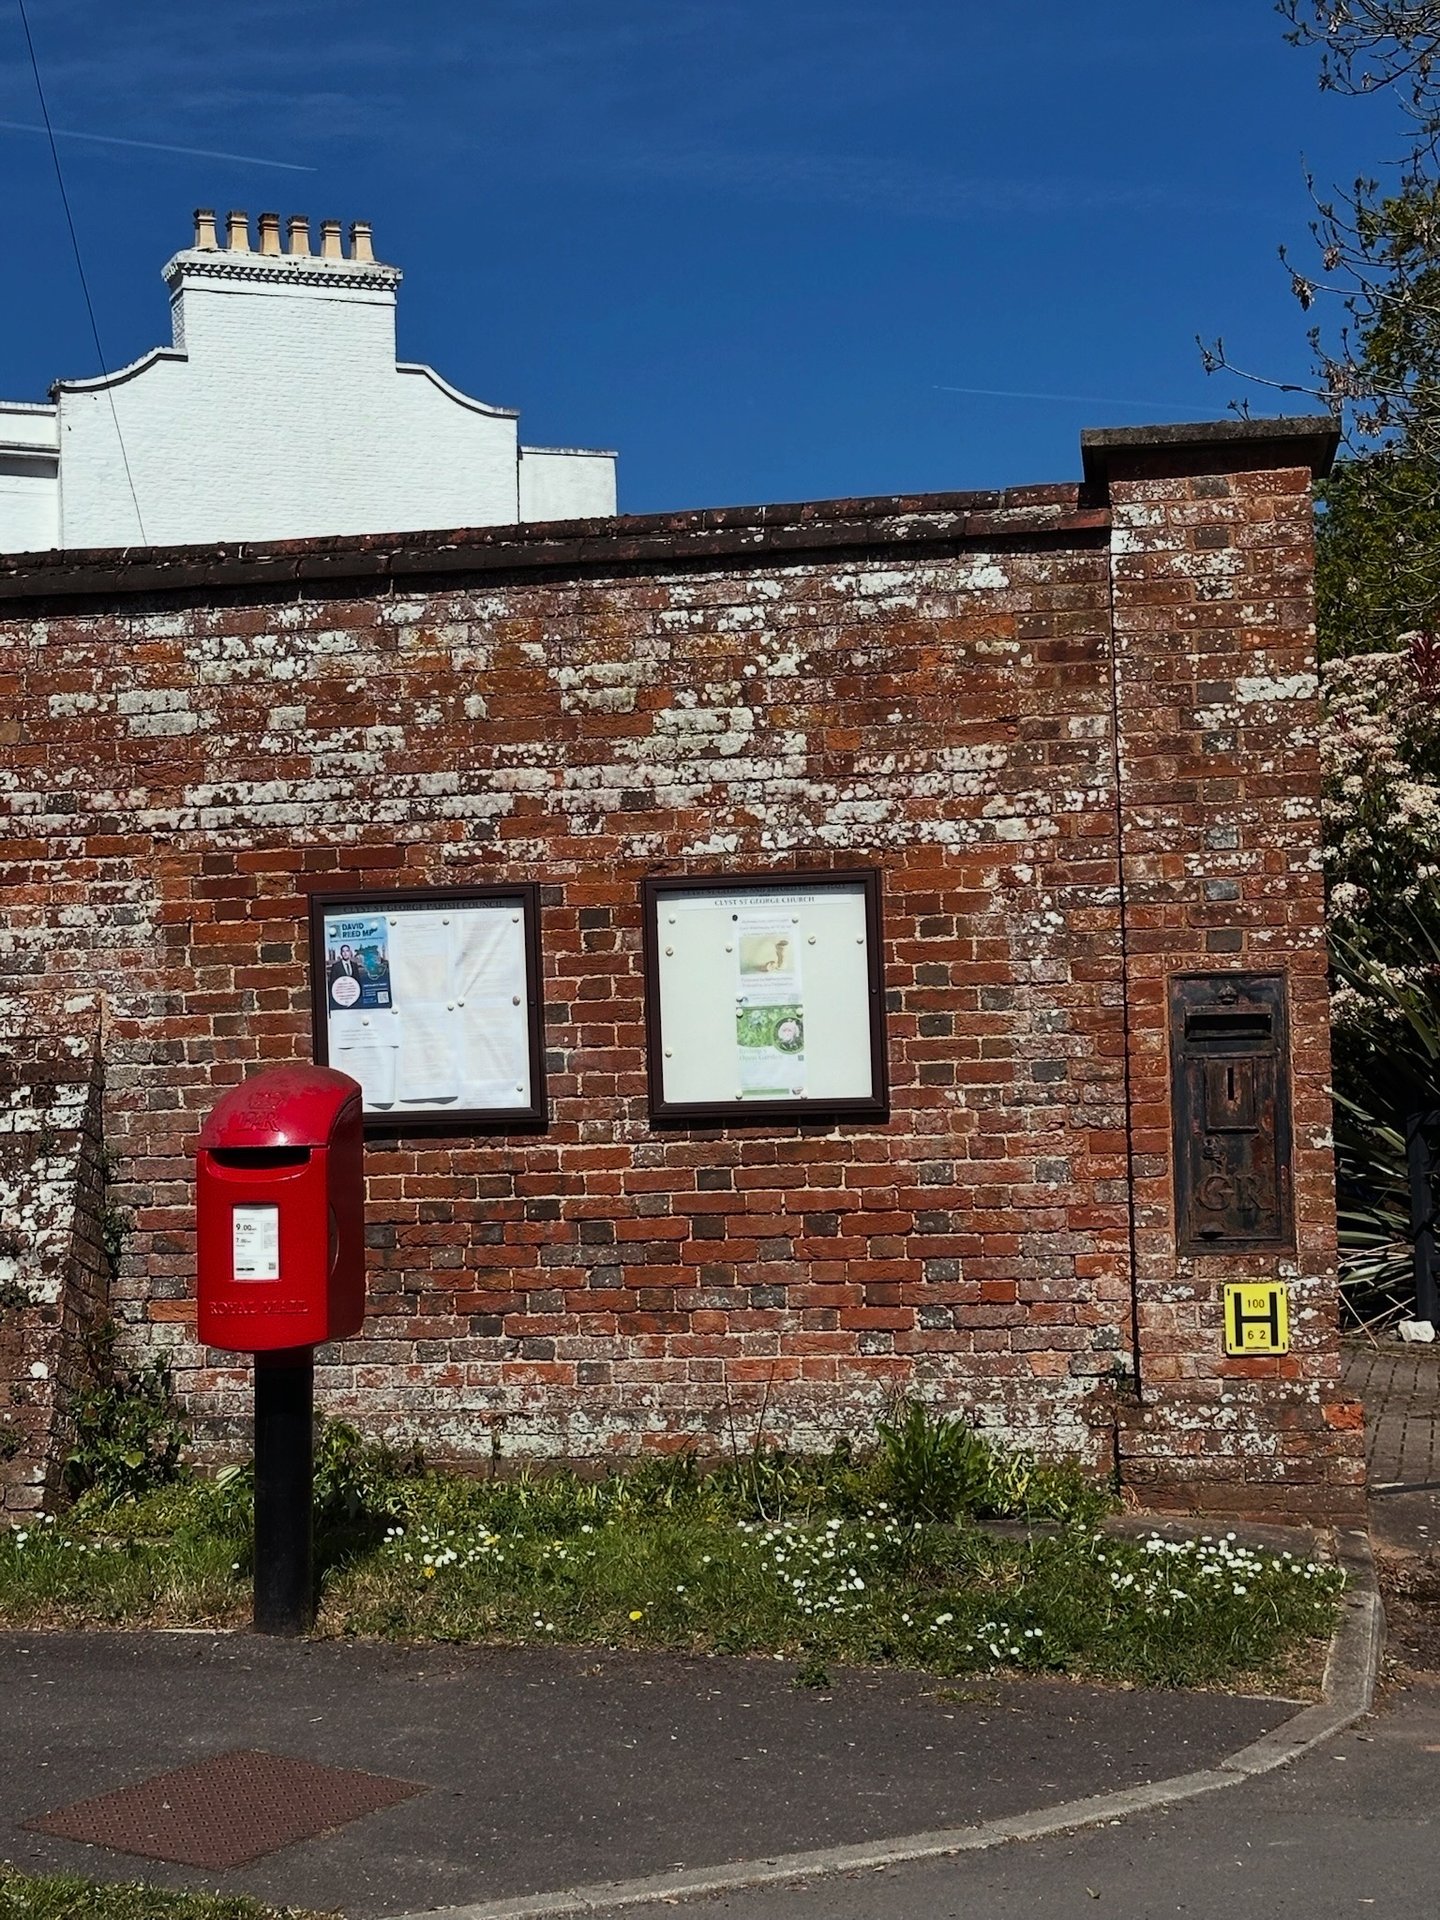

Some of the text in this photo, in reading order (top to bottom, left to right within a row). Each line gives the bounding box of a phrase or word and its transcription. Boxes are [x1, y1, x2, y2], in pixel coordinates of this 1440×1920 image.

[462, 900, 504, 909] COUNCIL
[749, 897, 779, 905] GEORGE
[341, 922, 364, 931] DAVID
[362, 929, 373, 937] MP
[1198, 1174, 1274, 1211] GR
[209, 1300, 309, 1316] ROYAL MAIL
[1247, 1299, 1265, 1308] 100
[1233, 1291, 1279, 1347] H
